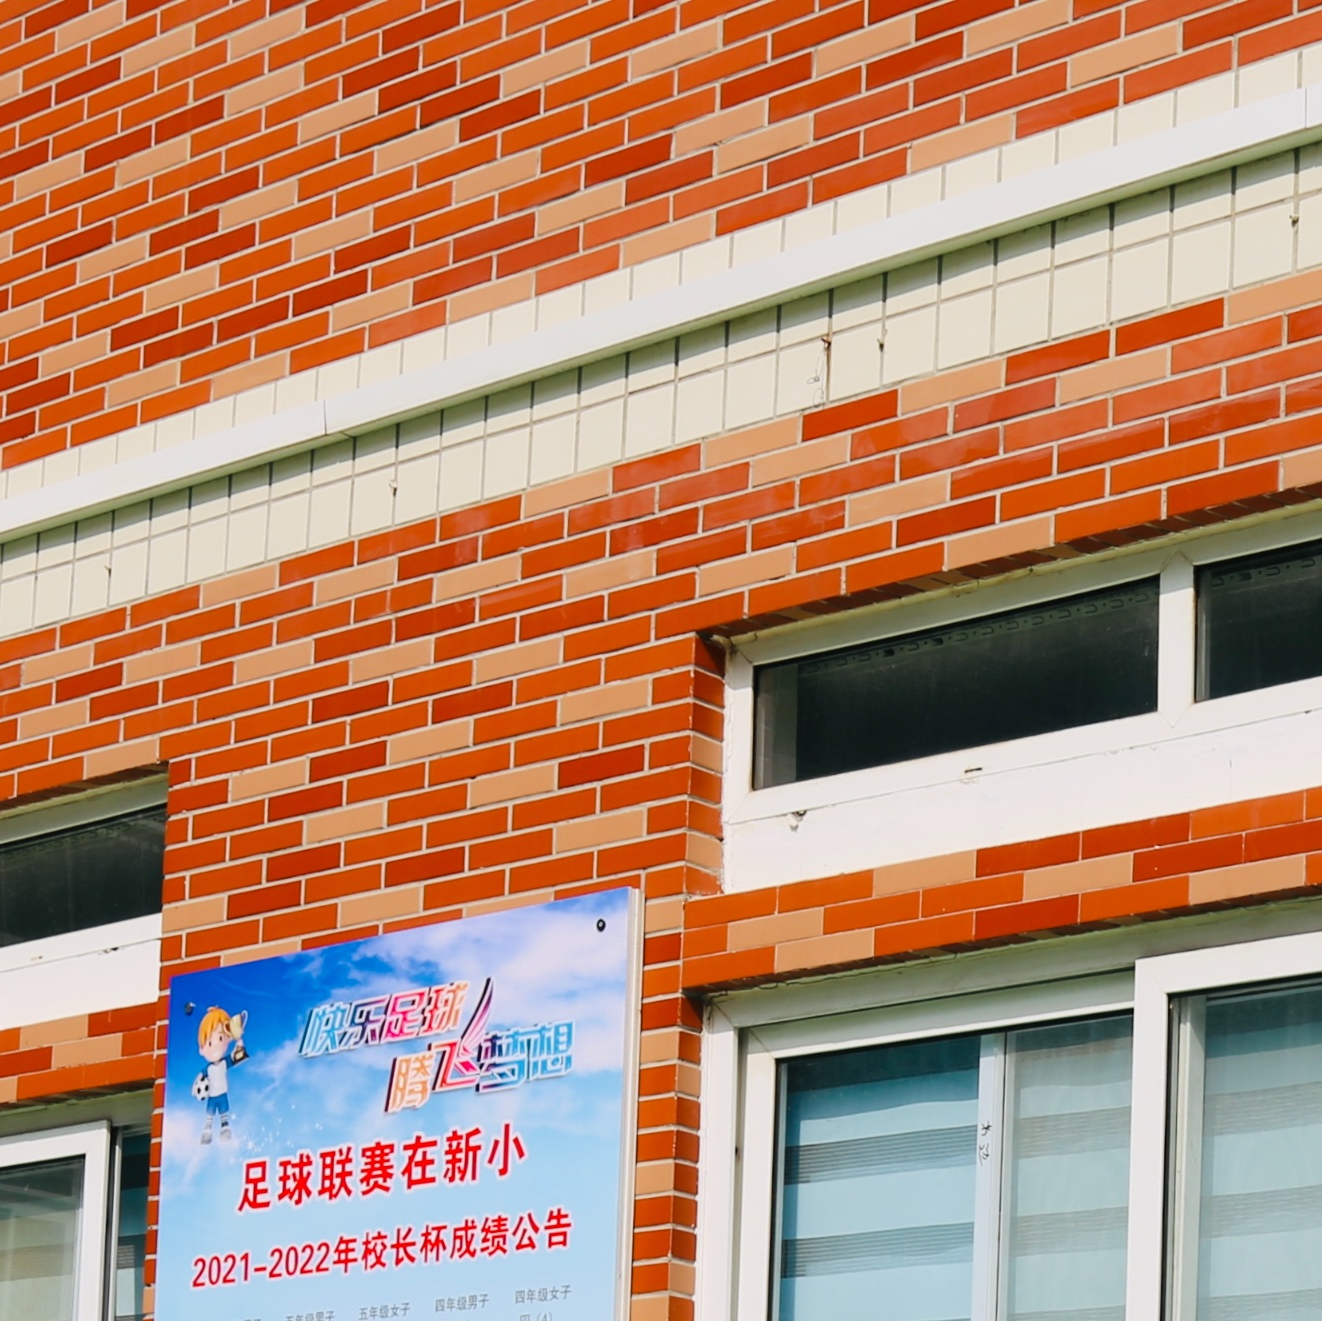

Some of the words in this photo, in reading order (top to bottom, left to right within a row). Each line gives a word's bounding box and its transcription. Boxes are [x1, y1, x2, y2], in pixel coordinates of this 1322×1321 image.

[299, 980, 469, 1058] 快乐足球
[385, 977, 574, 1113] 腾飞梦想
[238, 1123, 526, 1213] 足球联赛在新小
[192, 1208, 572, 1288] 2021-2022年校长杯成绩公告
[358, 1302, 411, 1321] 五年级女子
[435, 1293, 489, 1313] 四年级男子
[515, 1284, 572, 1304] 四年级女子
